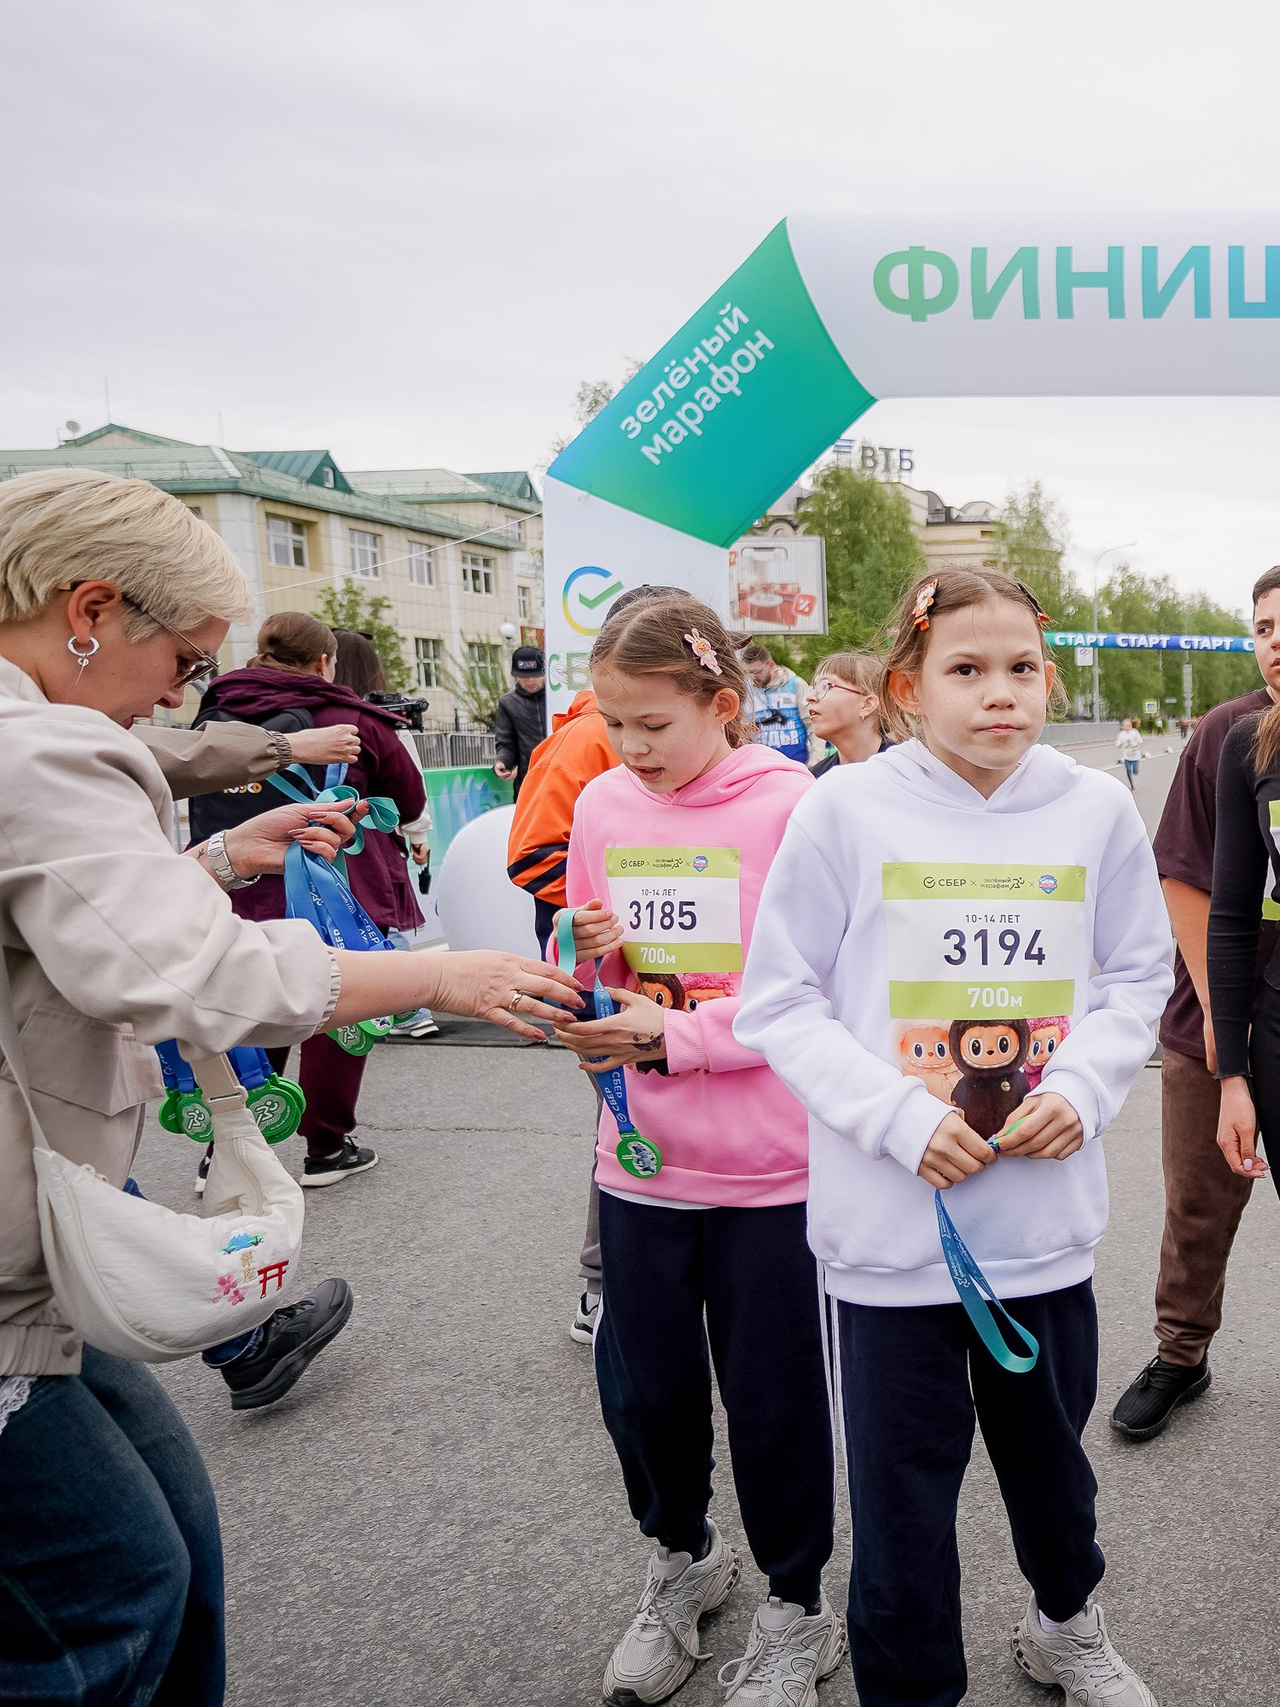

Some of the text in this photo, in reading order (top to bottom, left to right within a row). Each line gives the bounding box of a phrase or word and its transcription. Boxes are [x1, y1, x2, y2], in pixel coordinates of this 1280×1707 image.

[620, 302, 751, 440] зелёный
[640, 329, 775, 466] марафон
[861, 445, 914, 472] ВТБ
[1054, 632, 1108, 647] СТАРТ
[1115, 633, 1171, 649] СТАРТ
[1178, 635, 1234, 651] СТАРТ
[641, 888, 677, 896] 10-14 ЛЕТ
[938, 878, 967, 887] СБЕР
[629, 900, 697, 931] 3185
[965, 914, 1020, 923] 10-14 ЛЕТ
[943, 929, 1046, 966] 3194
[611, 1071, 623, 1099] СБЕР
[604, 1086, 620, 1112] СБЕР
